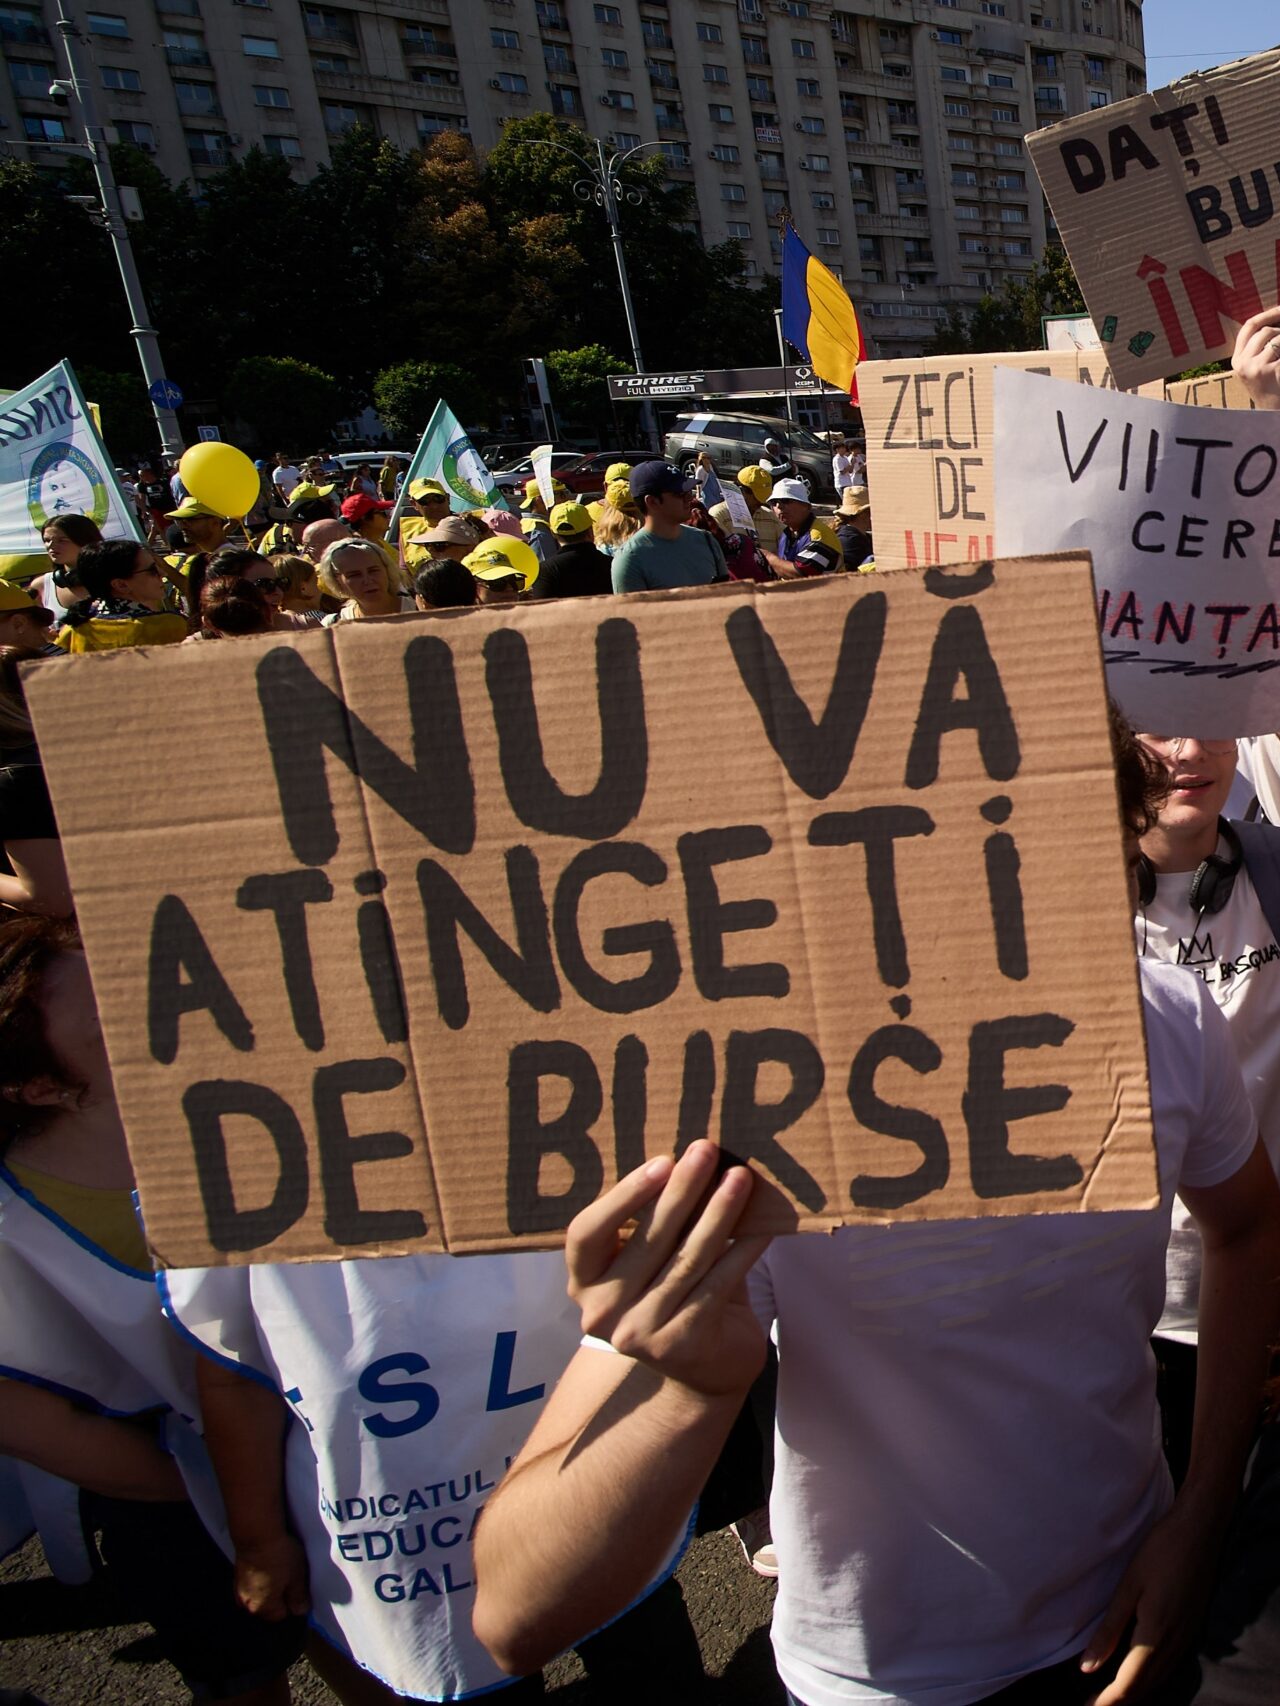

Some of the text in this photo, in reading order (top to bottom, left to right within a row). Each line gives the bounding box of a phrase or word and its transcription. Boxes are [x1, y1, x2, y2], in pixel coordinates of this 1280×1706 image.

[614, 374, 705, 387] TORRES
[627, 387, 649, 395] FULL
[794, 380, 815, 388] KGM
[935, 457, 986, 521] DE
[256, 564, 1022, 866] NU VĂ
[181, 1013, 1086, 1254] DE BURSE
[374, 1563, 478, 1603] GAL
